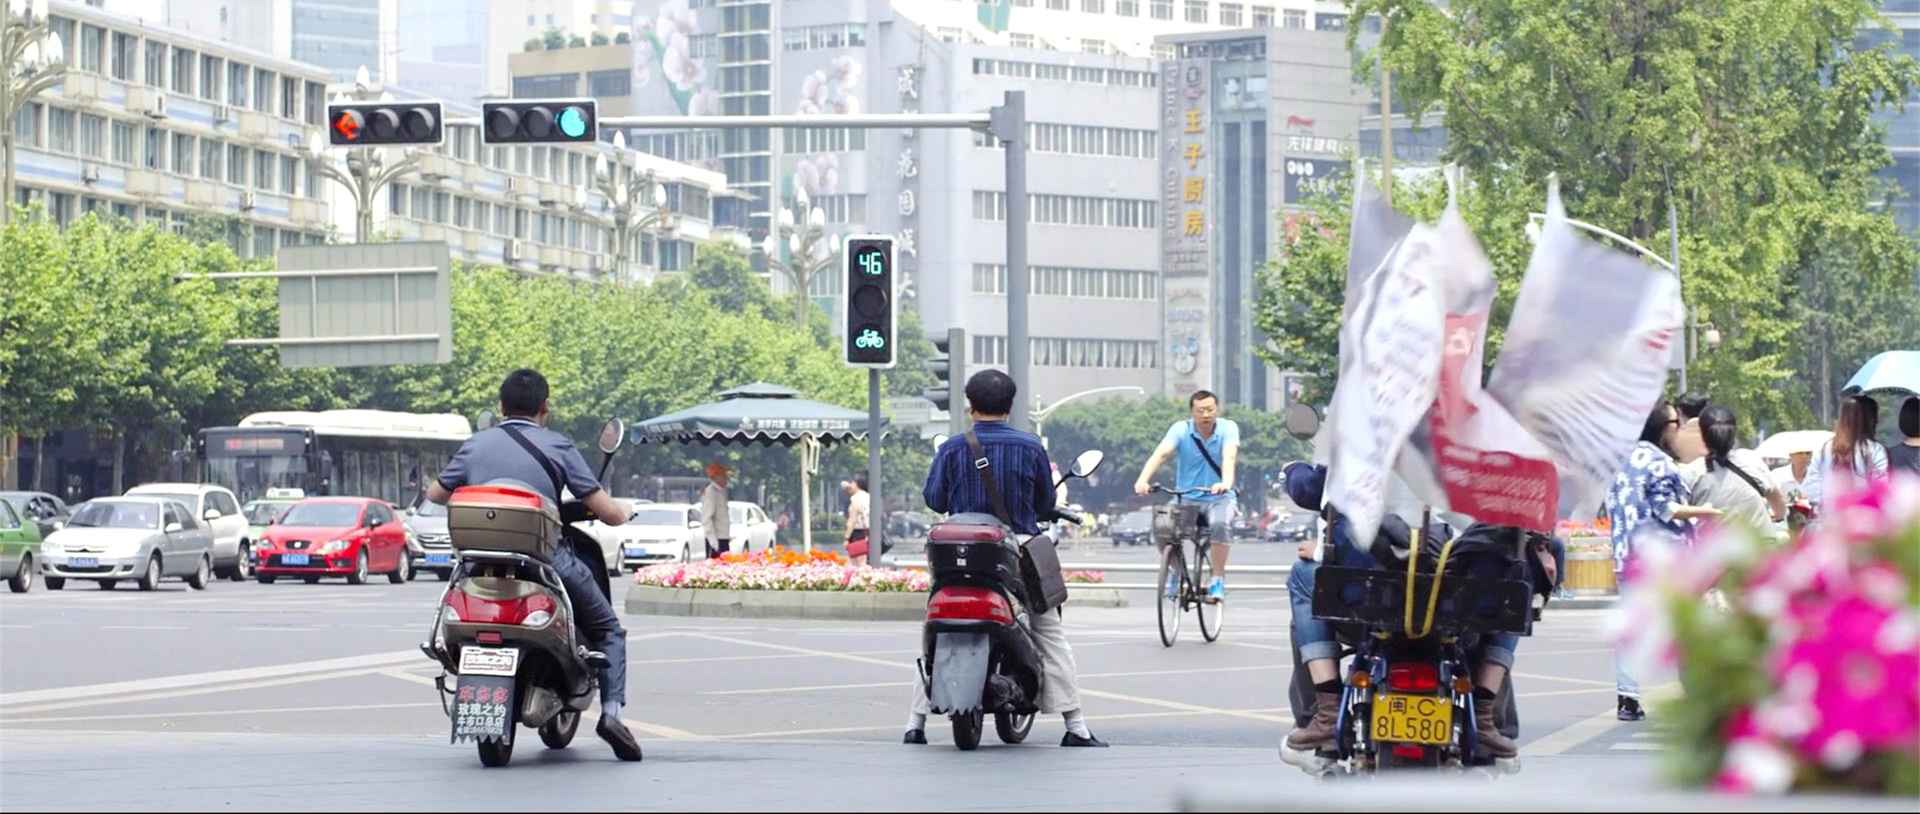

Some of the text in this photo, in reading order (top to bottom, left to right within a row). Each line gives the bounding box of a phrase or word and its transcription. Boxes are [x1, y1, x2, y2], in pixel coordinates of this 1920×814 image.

[1184, 108, 1206, 237] 王子厨房
[859, 252, 882, 275] 46
[458, 703, 506, 717] 玫瑰之约
[1376, 716, 1446, 741] 8L580
